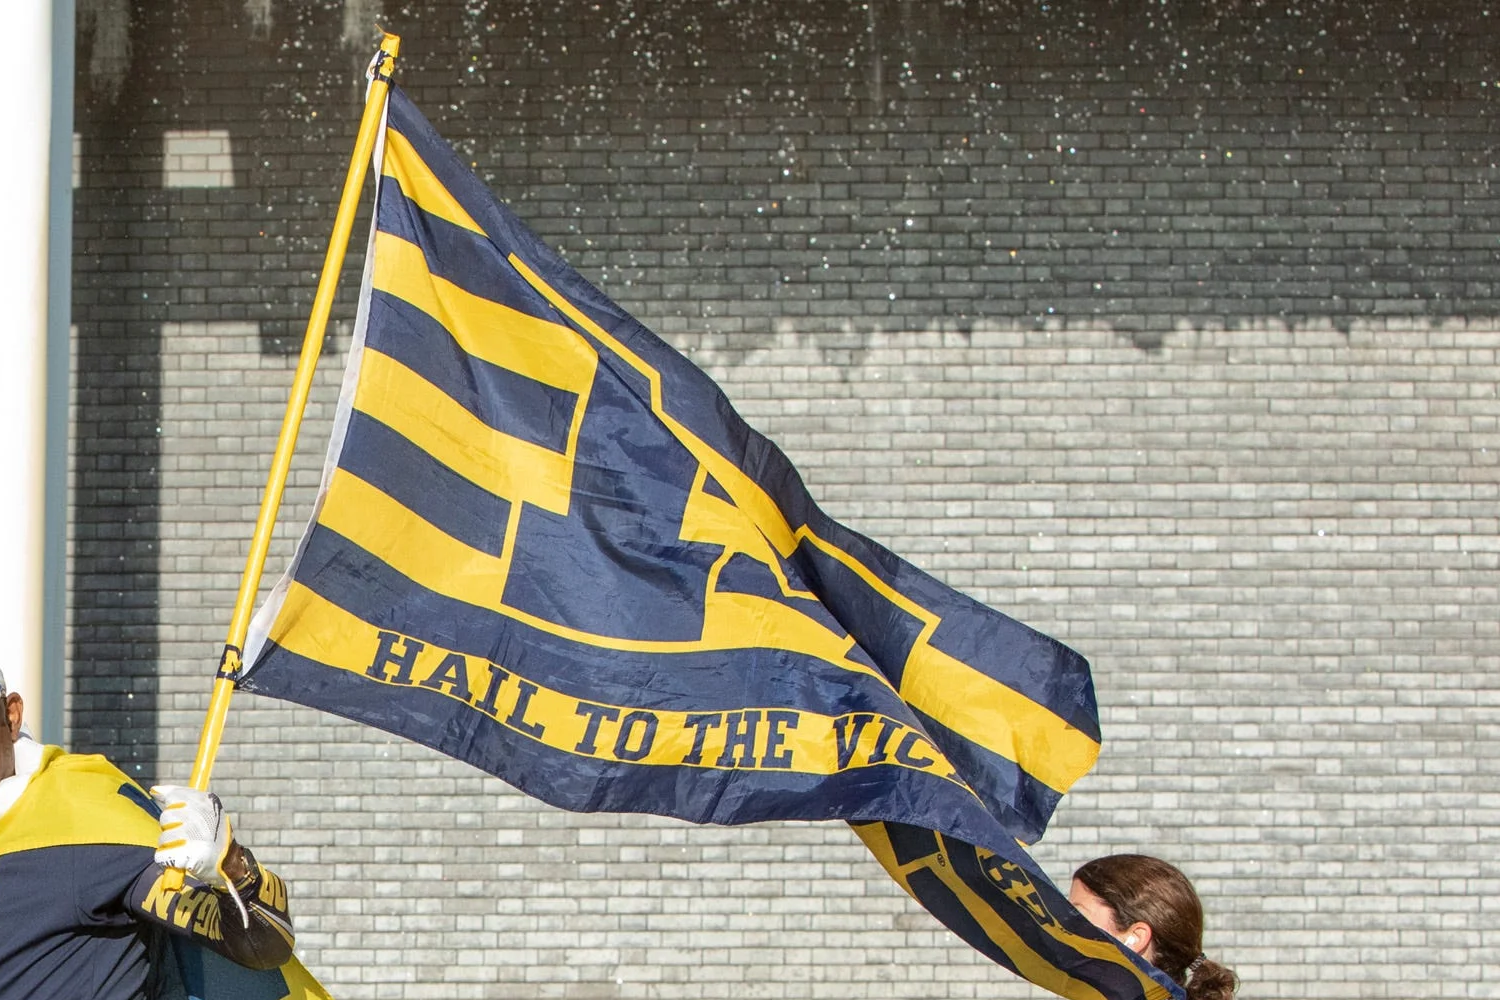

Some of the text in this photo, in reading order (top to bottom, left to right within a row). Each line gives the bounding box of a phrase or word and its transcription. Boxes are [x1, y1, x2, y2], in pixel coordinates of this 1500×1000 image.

[365, 630, 940, 770] HAIL TO THE VIC
